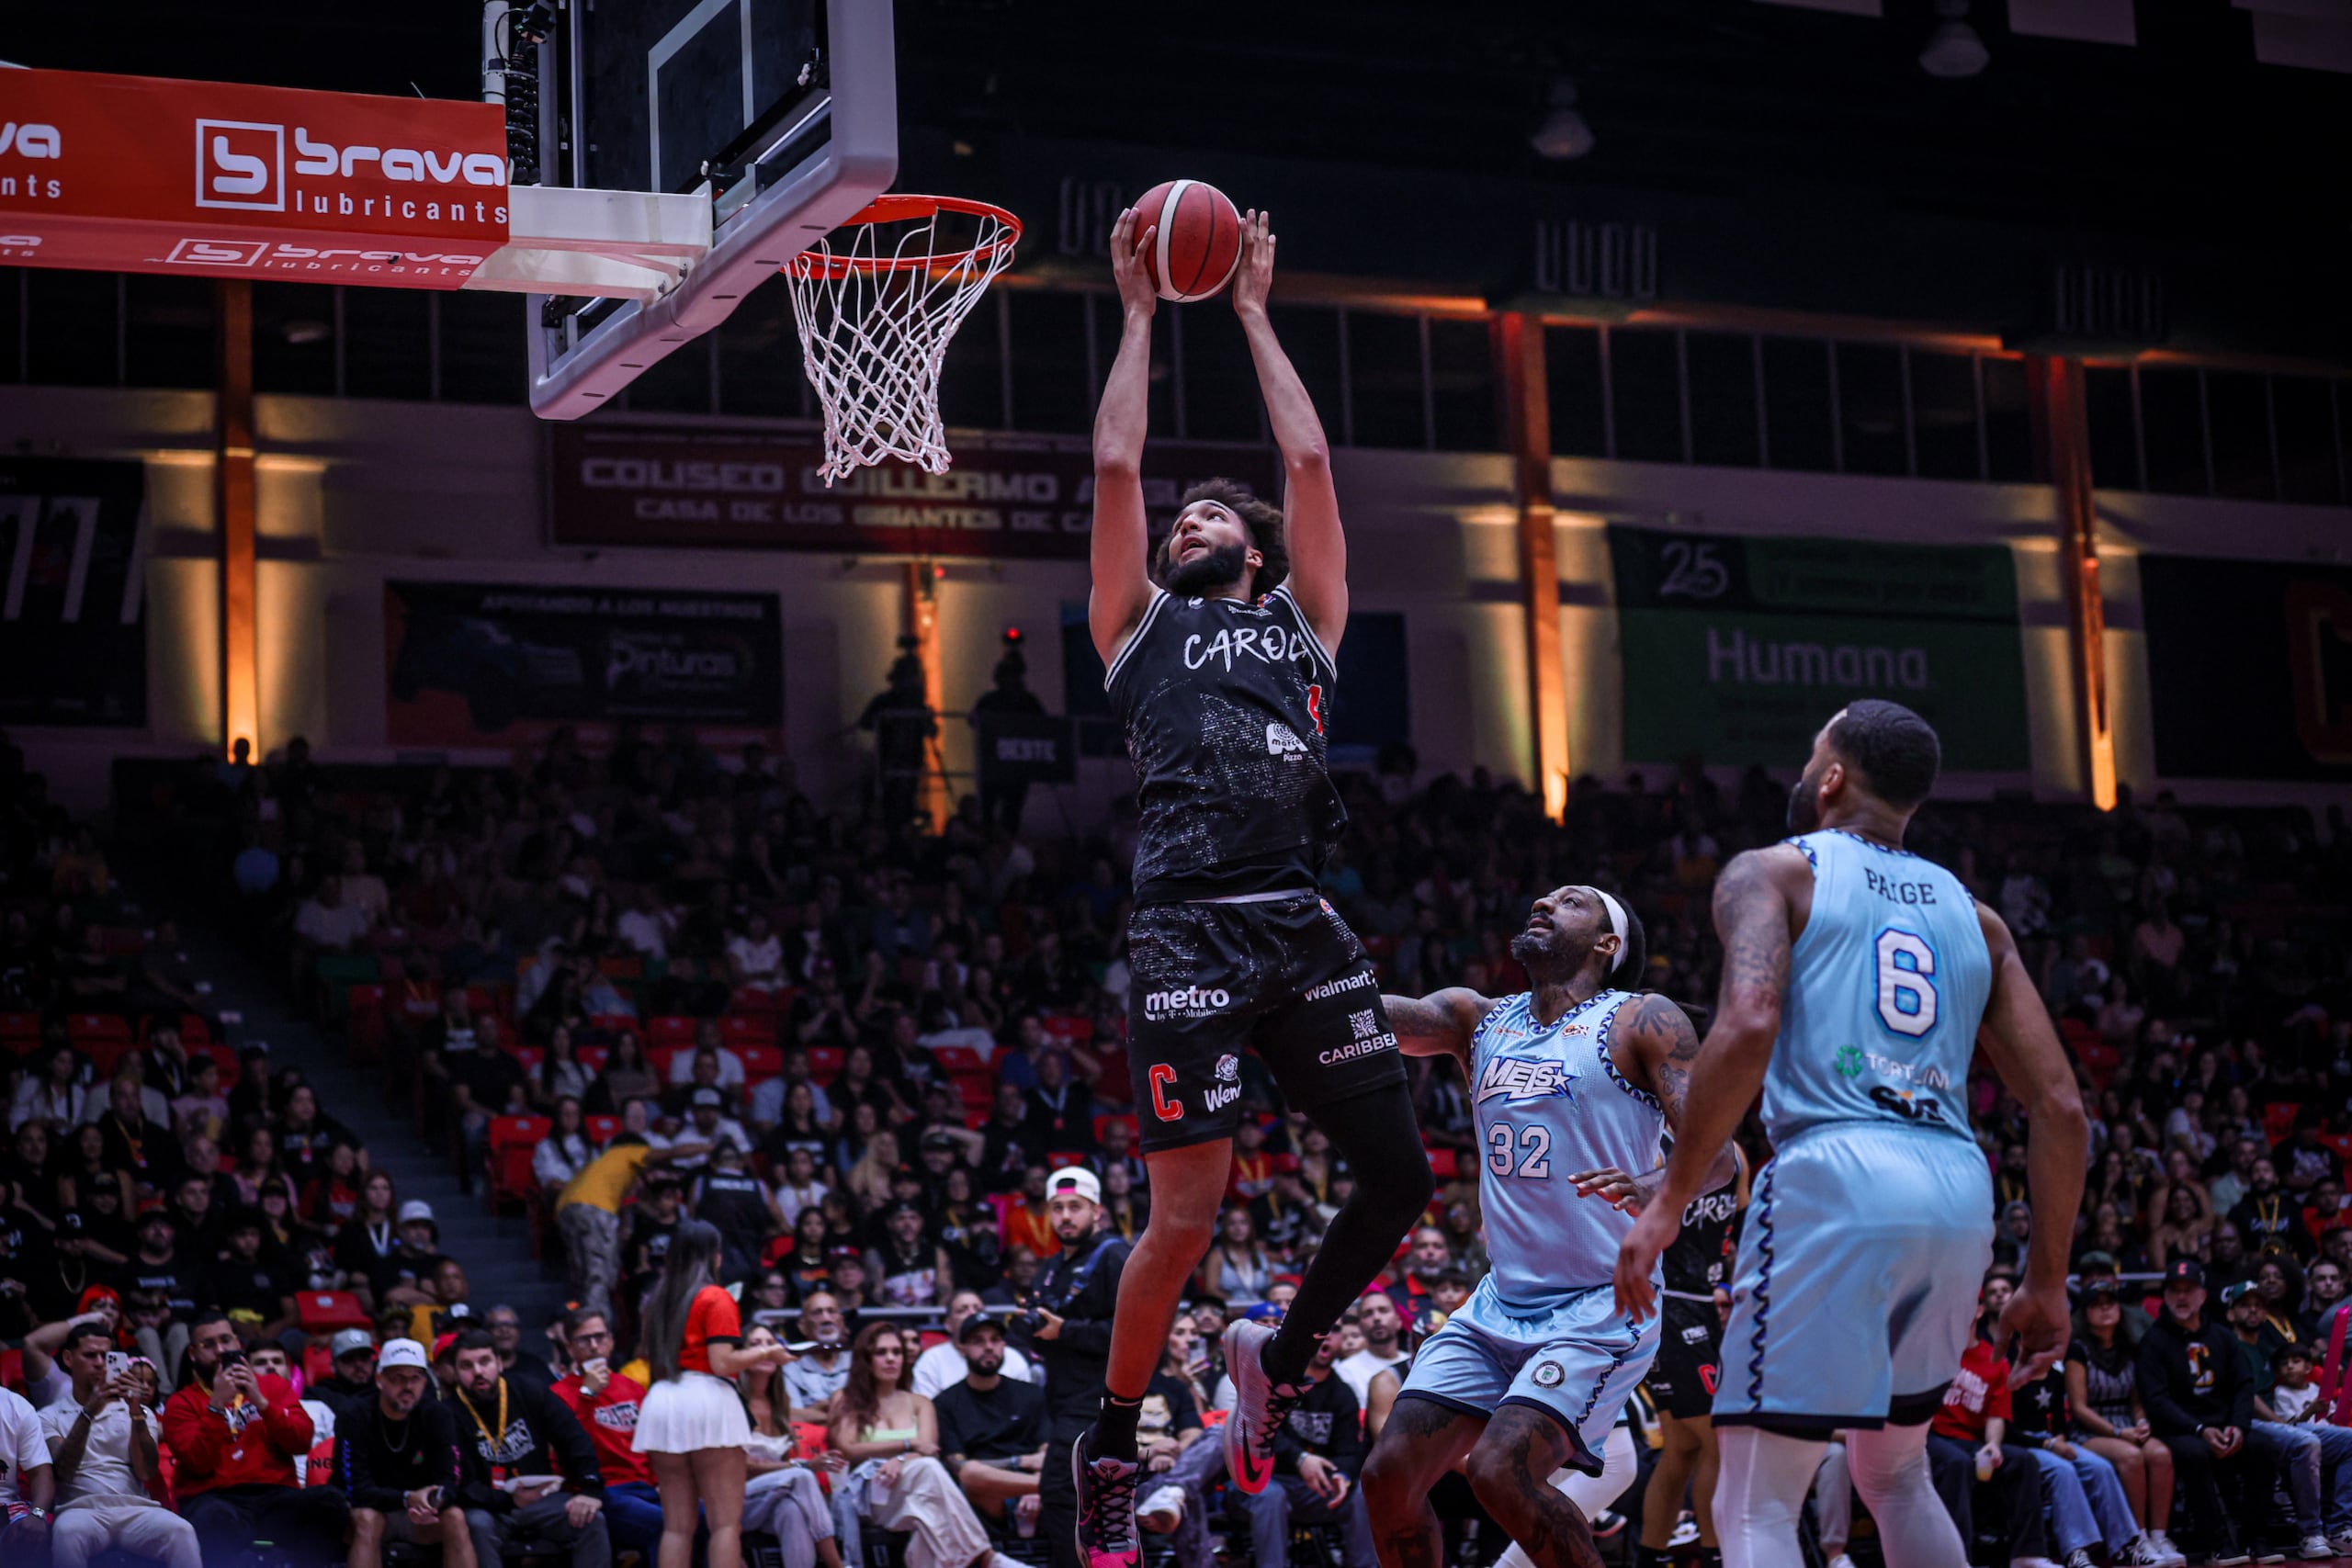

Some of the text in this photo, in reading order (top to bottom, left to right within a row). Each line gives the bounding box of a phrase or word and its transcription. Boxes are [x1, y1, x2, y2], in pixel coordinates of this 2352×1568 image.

[294, 127, 506, 187] brava
[296, 189, 508, 224] lubricants
[264, 259, 472, 277] lubricants
[272, 243, 484, 265] brava
[580, 457, 785, 493] COLISEO
[633, 497, 719, 522] CASA
[729, 500, 774, 523] DE
[782, 502, 844, 525] LOS
[1012, 511, 1055, 532] DE
[1705, 626, 1931, 689] Humana
[1863, 867, 1938, 905] PAIGE
[1145, 985, 1231, 1012] metro
[1305, 970, 1372, 1003] Walmart
[1874, 927, 1939, 1038] 6
[1148, 1062, 1185, 1122] C
[1477, 1056, 1566, 1105] METS
[1487, 1122, 1551, 1179] 32
